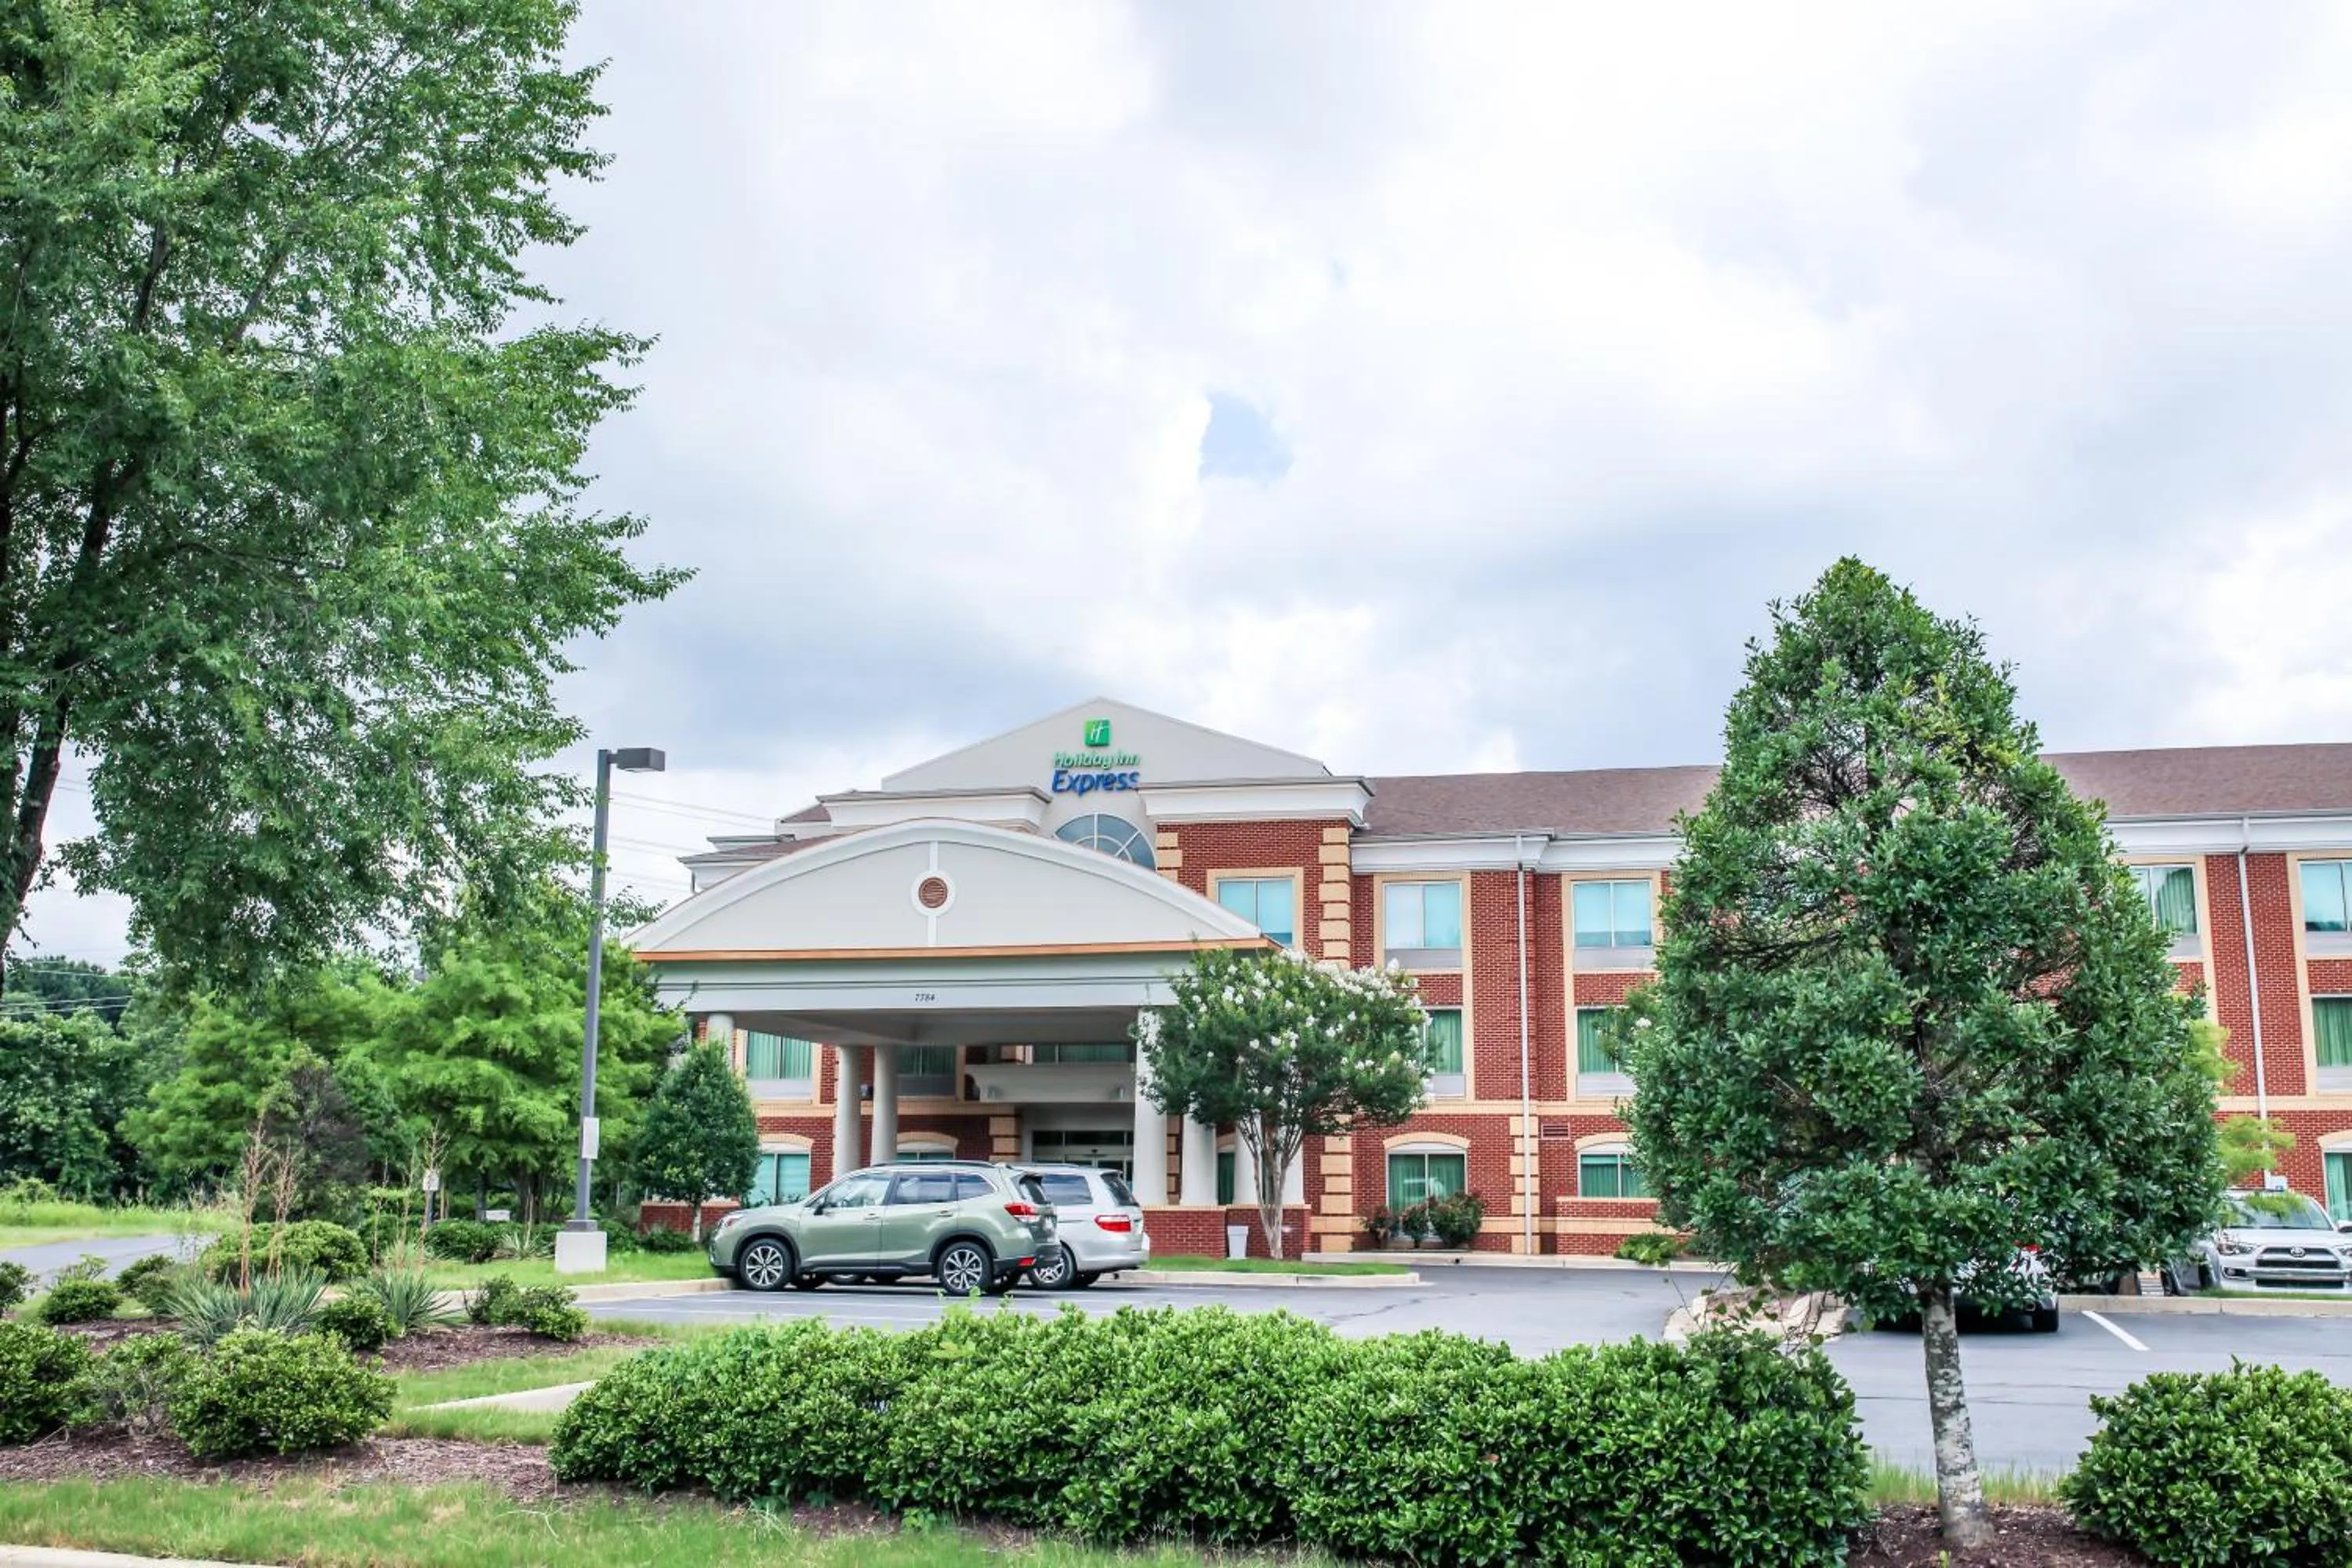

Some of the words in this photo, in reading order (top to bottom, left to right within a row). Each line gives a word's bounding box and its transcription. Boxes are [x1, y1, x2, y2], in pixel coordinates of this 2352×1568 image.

[1053, 751, 1113, 770] Holiday
[1116, 750, 1142, 766] Inn
[1051, 769, 1140, 797] Express
